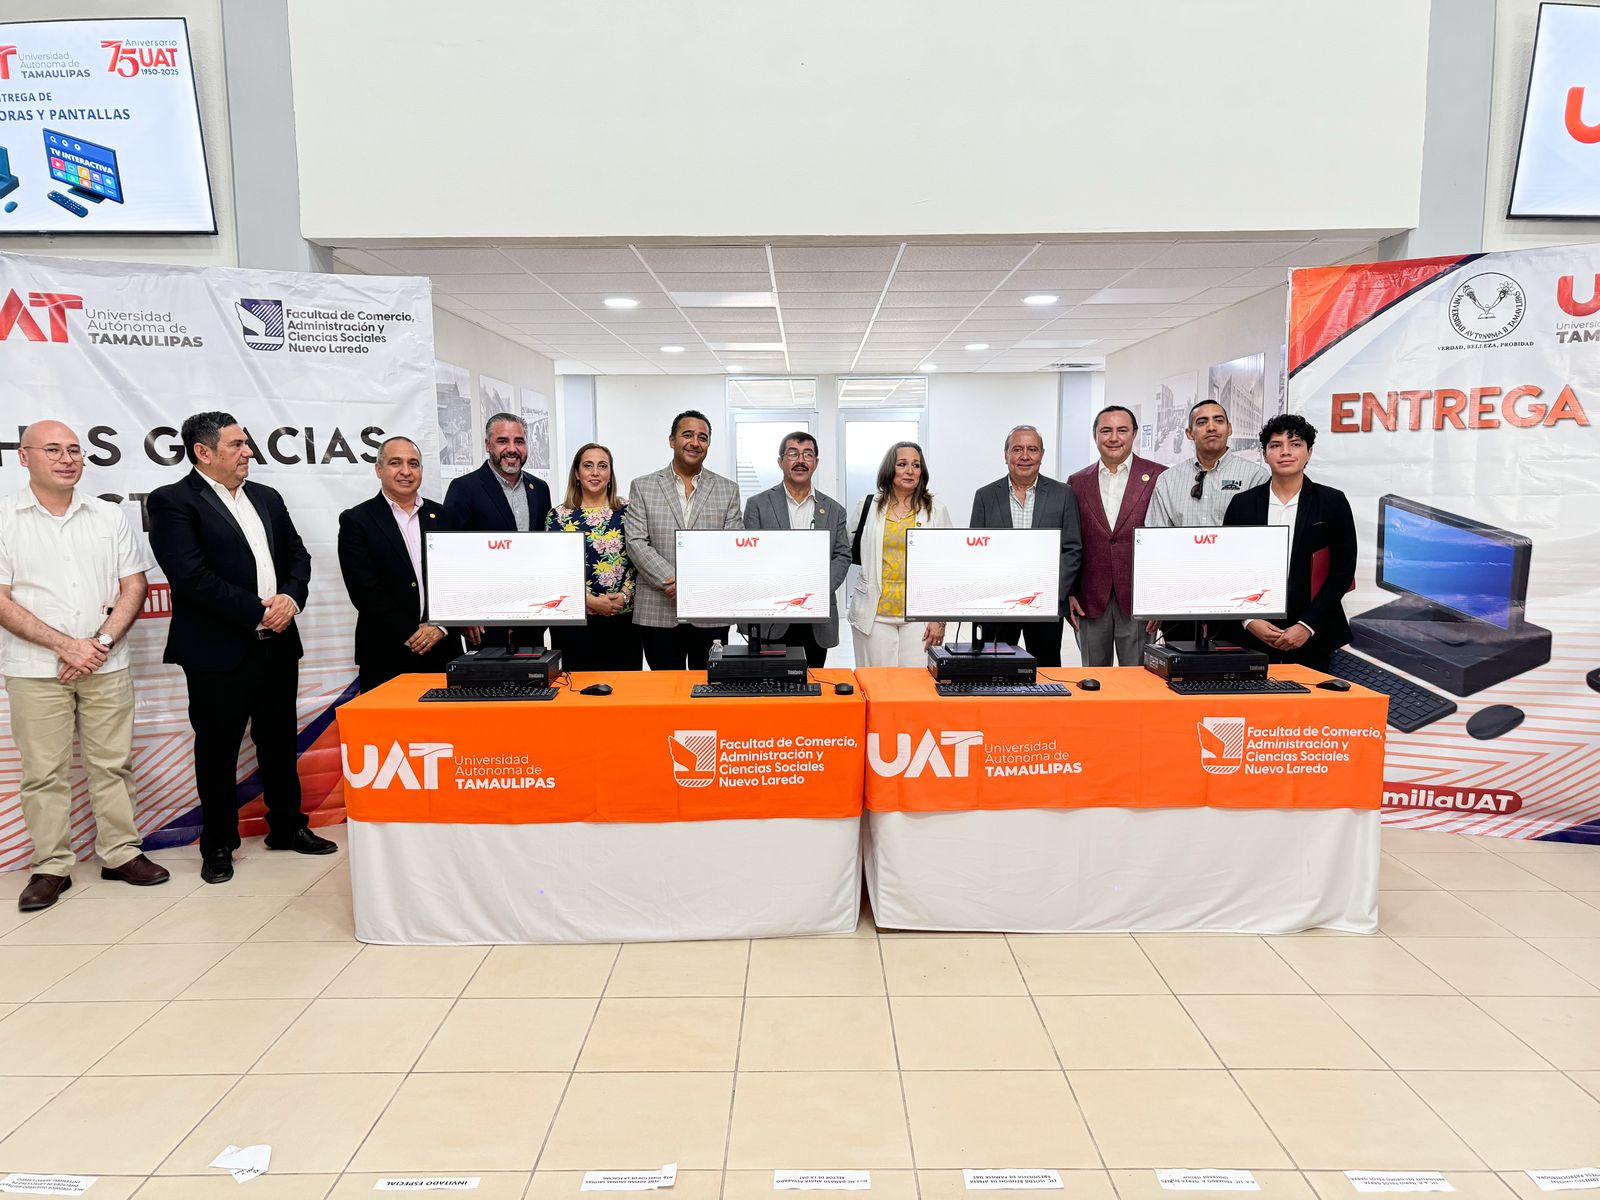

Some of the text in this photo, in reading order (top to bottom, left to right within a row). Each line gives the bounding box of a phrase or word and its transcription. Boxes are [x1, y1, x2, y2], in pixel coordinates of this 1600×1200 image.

[18, 52, 70, 60] Universidad
[101, 41, 178, 78] 75 UAT
[20, 60, 80, 69] Autónoma de
[21, 69, 91, 78] TAMAULIPAS
[0, 92, 52, 102] TREGA DE
[37, 109, 45, 120] Y
[49, 109, 130, 120] PANTALLAS
[49, 147, 114, 174] TV INTERACTIVA
[85, 309, 172, 322] Universidad
[286, 309, 415, 322] Facultad de Comercio,
[87, 320, 187, 333] Autónoma de
[287, 321, 385, 334] Administración y
[88, 333, 204, 347] TAMAULIPAS
[288, 332, 387, 343] Ciencias Sociales
[289, 343, 369, 353] Nuevo Laredo
[1331, 384, 1590, 433] ENTREGA
[488, 540, 512, 549] UAT
[736, 537, 760, 547] UAT
[967, 536, 990, 546] UAT
[1194, 534, 1218, 544] UAT
[1247, 726, 1383, 740] Facultad de Comercio,
[720, 736, 858, 750] Facultad de Comercio,
[984, 739, 1056, 754] Universidad
[1246, 739, 1349, 751] Administración y
[719, 749, 824, 762] Administración y
[867, 728, 984, 778] UAT
[984, 750, 1069, 764] Autónoma de
[1246, 751, 1349, 762] Ciencias Sociales
[341, 740, 454, 790] UAT
[454, 754, 529, 766] Universidad
[455, 764, 542, 776] Autónoma de
[719, 762, 825, 775] Ciencias Sociales
[985, 762, 1082, 777] TAMAULIPAS
[1244, 764, 1329, 774] Nuevo Laredo
[455, 777, 556, 790] TAMAULIPAS
[719, 774, 805, 787] Nuevo Laredo
